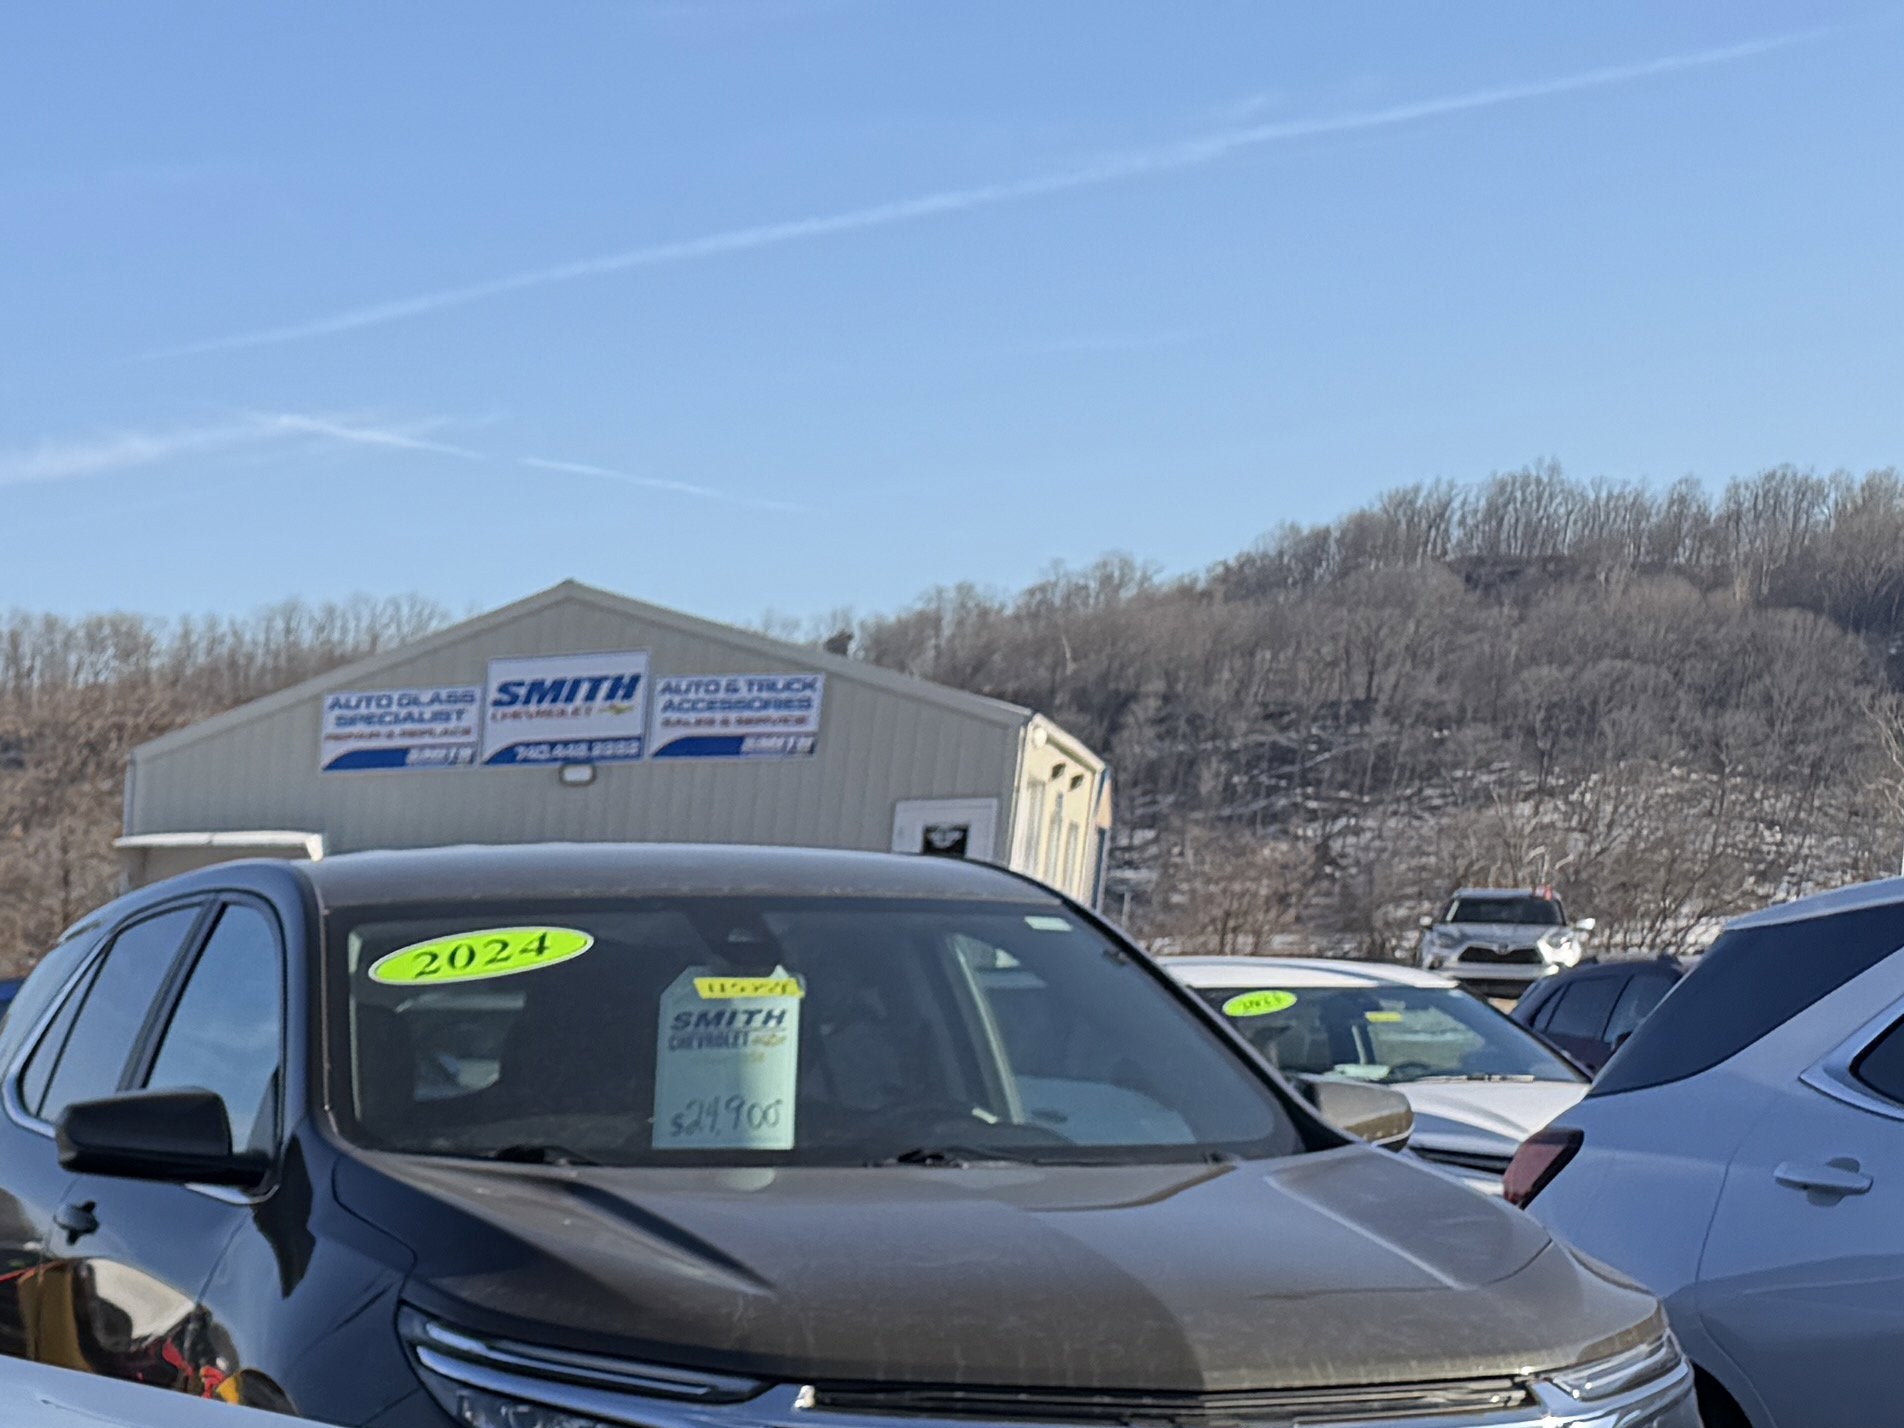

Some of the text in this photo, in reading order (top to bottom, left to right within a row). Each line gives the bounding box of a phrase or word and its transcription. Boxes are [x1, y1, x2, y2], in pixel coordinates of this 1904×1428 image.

[491, 673, 642, 707] SMITH
[660, 676, 819, 696] AUTO & TRUCK
[328, 689, 476, 711] AUTO GLASS
[661, 697, 814, 713] ACCESSORIES
[334, 708, 467, 728] SPECIALIST
[490, 705, 593, 722] CHEVROLET
[413, 931, 550, 980] 2024
[670, 1009, 788, 1031] SMITH
